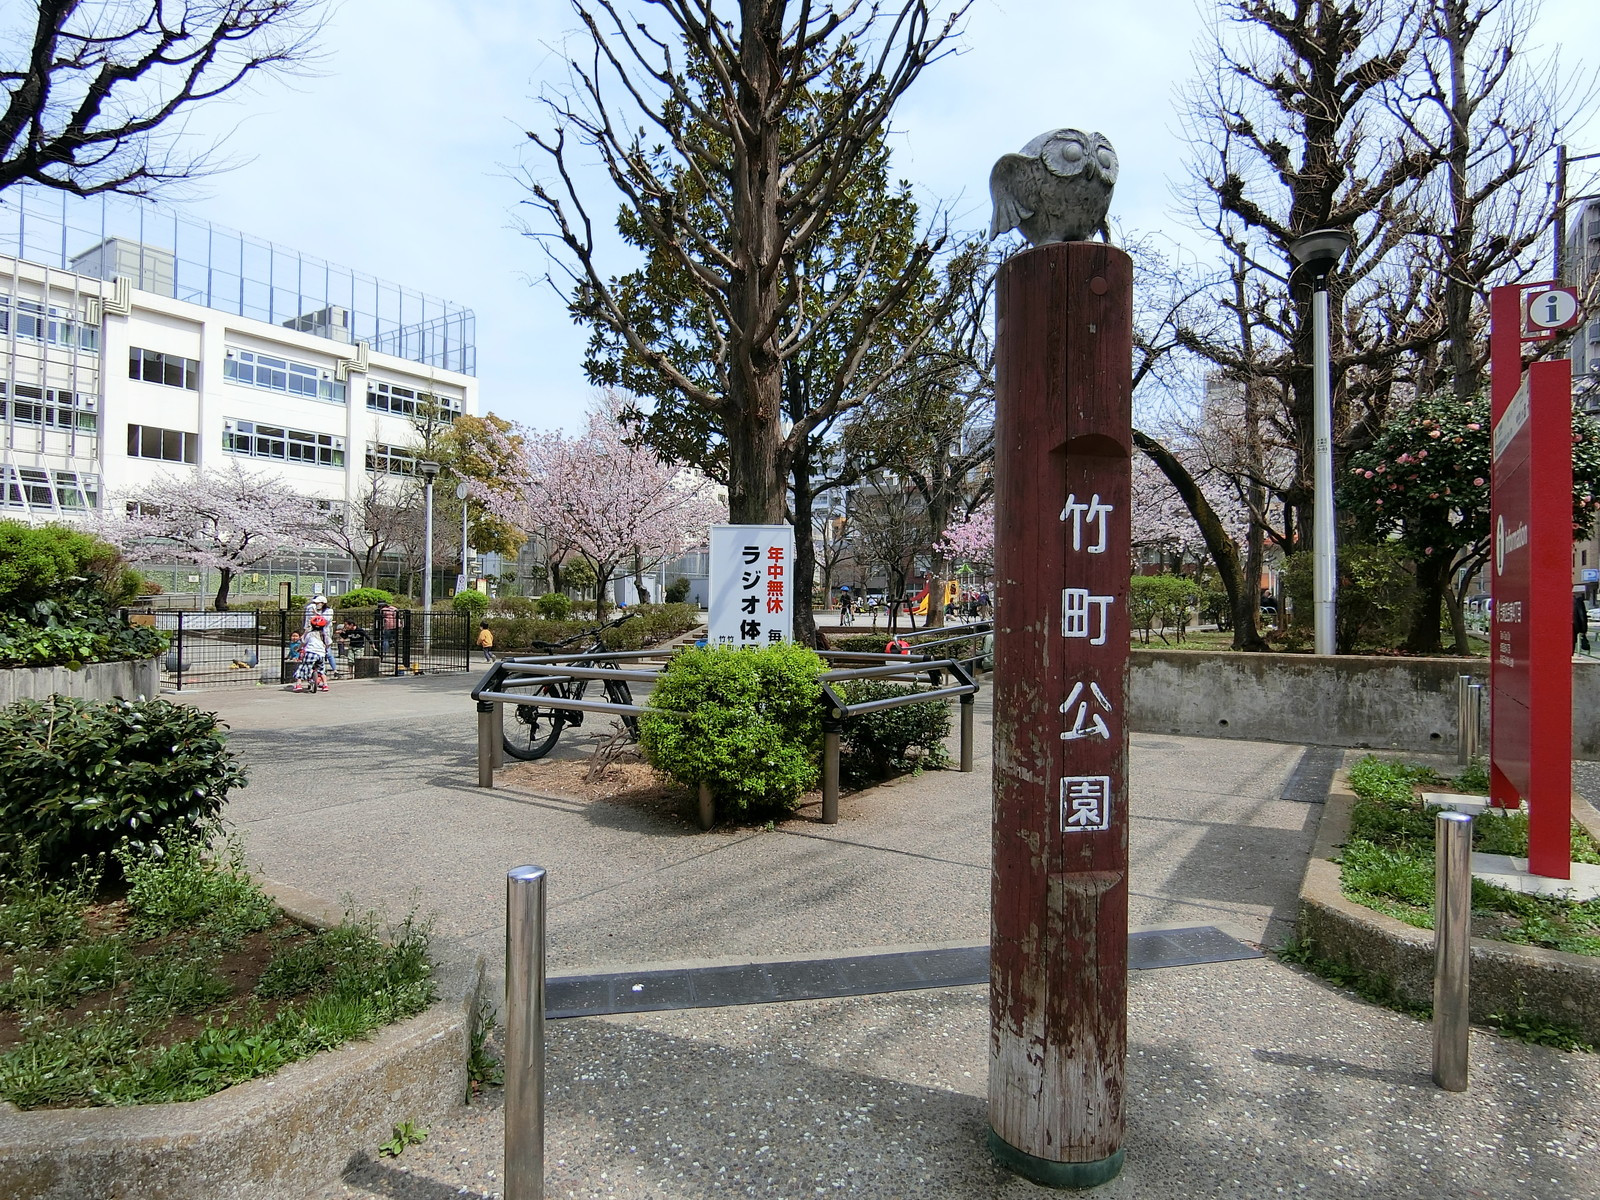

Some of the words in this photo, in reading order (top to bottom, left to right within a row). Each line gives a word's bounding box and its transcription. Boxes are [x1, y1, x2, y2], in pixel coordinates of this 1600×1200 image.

[766, 546, 785, 614] 年中無休
[1583, 570, 1597, 581] P
[1059, 494, 1115, 832] 竹町公園
